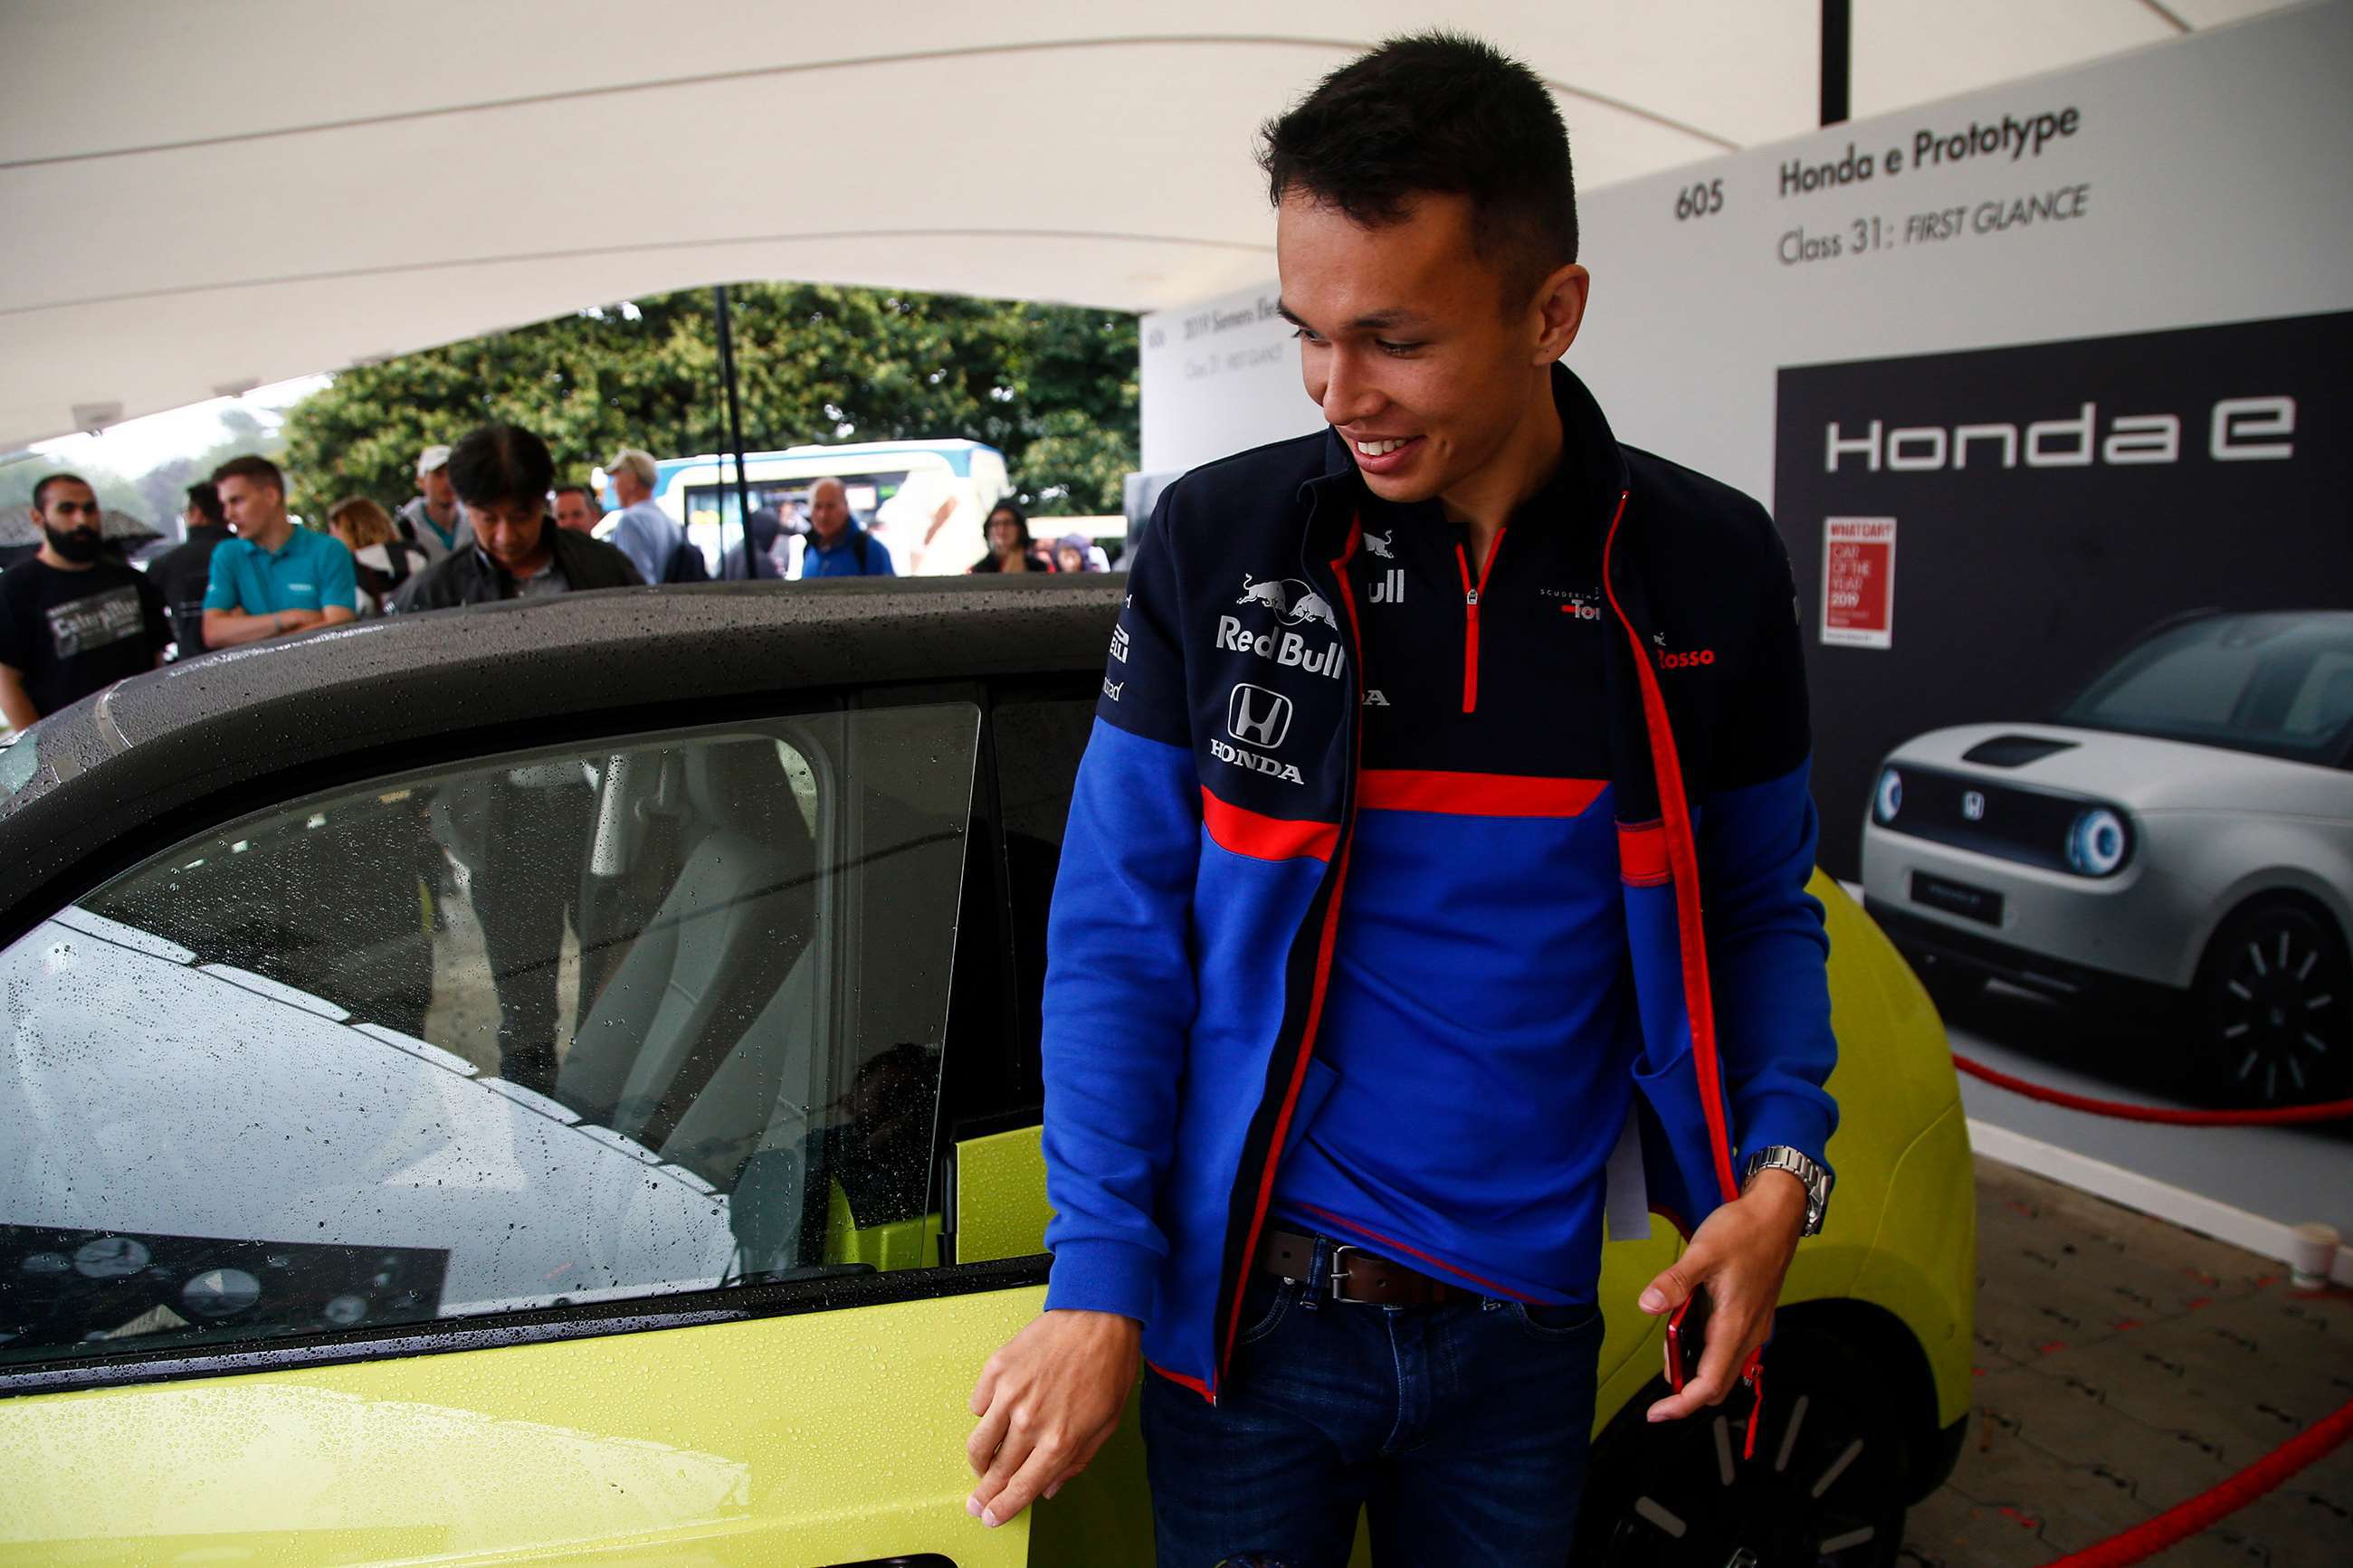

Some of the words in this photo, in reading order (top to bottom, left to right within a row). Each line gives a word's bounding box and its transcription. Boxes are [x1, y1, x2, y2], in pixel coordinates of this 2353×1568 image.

[1778, 143, 1874, 197] Honda
[1885, 150, 1903, 176] e
[1912, 106, 2081, 169] Prototype
[1674, 179, 1724, 222] 605
[1778, 228, 1843, 265] Class
[1850, 215, 1895, 255] 31:
[1904, 205, 1967, 246] FIRST
[1972, 184, 2091, 233] GLANCE
[1825, 402, 2181, 472] Honda
[2209, 395, 2296, 461] e
[1368, 569, 1405, 603] ull
[1216, 615, 1280, 660] Red
[1277, 632, 1346, 679] Bull
[1210, 738, 1304, 785] HONDA
